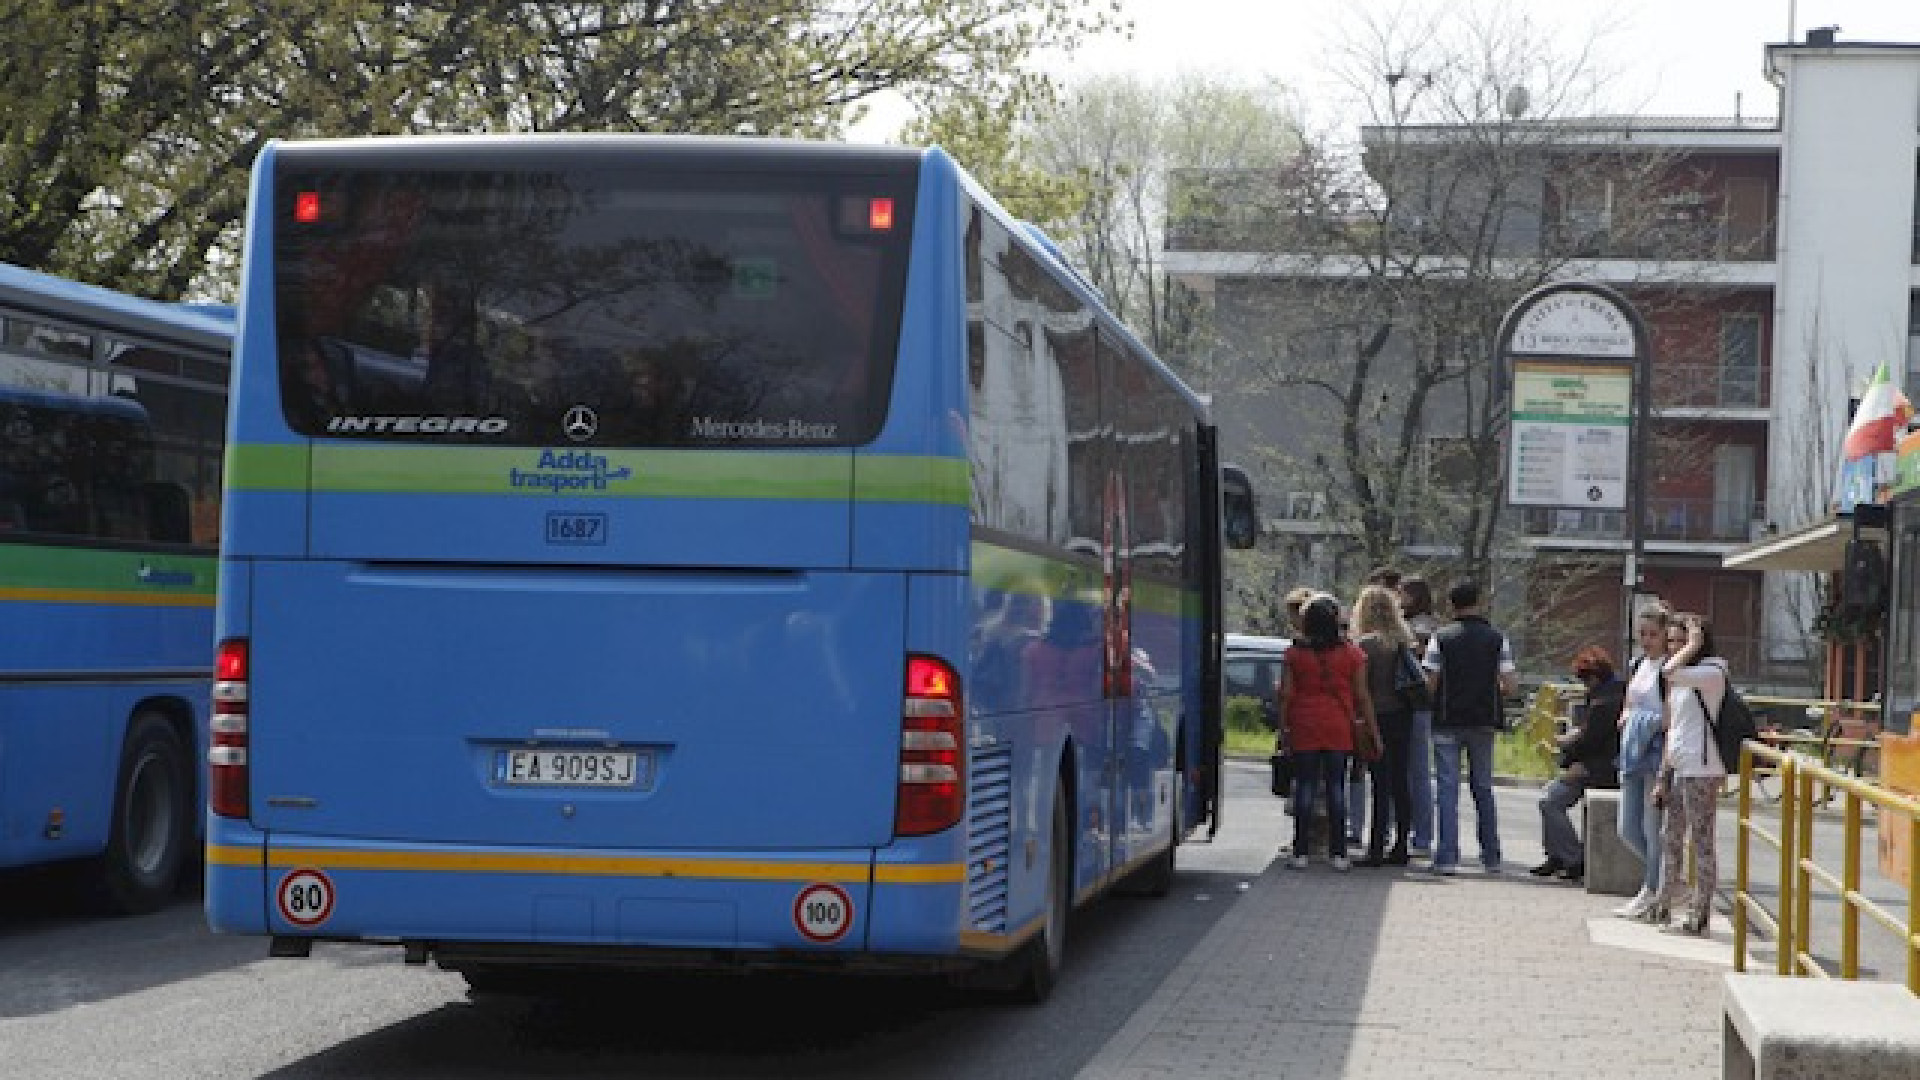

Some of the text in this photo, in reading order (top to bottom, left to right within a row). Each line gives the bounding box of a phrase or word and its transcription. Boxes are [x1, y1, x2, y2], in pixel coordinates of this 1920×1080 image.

[326, 416, 509, 434] INTEGRO
[690, 417, 838, 441] Mercedes-Benz
[538, 449, 607, 469] Adda
[509, 467, 608, 491] trasporti
[551, 518, 600, 538] 1687
[512, 753, 631, 781] EA 909SJ
[290, 883, 322, 913] 80
[806, 902, 841, 925] 100
